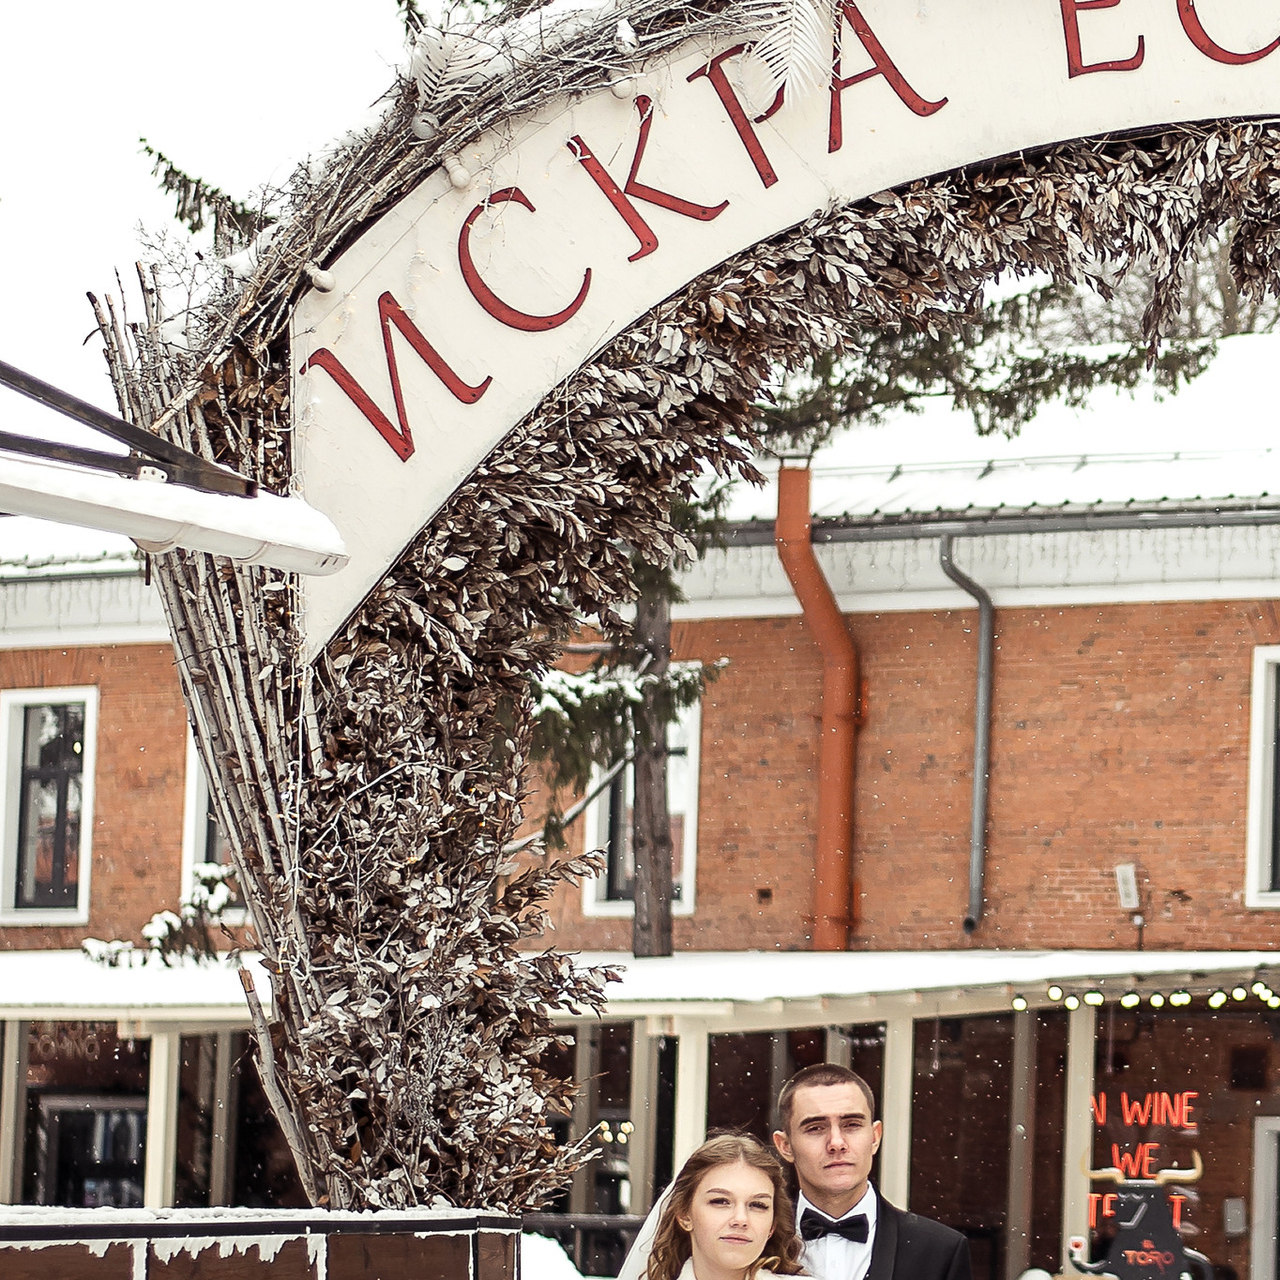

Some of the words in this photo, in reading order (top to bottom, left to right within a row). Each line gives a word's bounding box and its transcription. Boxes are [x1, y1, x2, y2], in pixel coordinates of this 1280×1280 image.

[1090, 1091, 1106, 1126] N
[1121, 1090, 1199, 1128] WINE
[1111, 1141, 1160, 1178] WE
[1123, 1250, 1175, 1275] TORO
